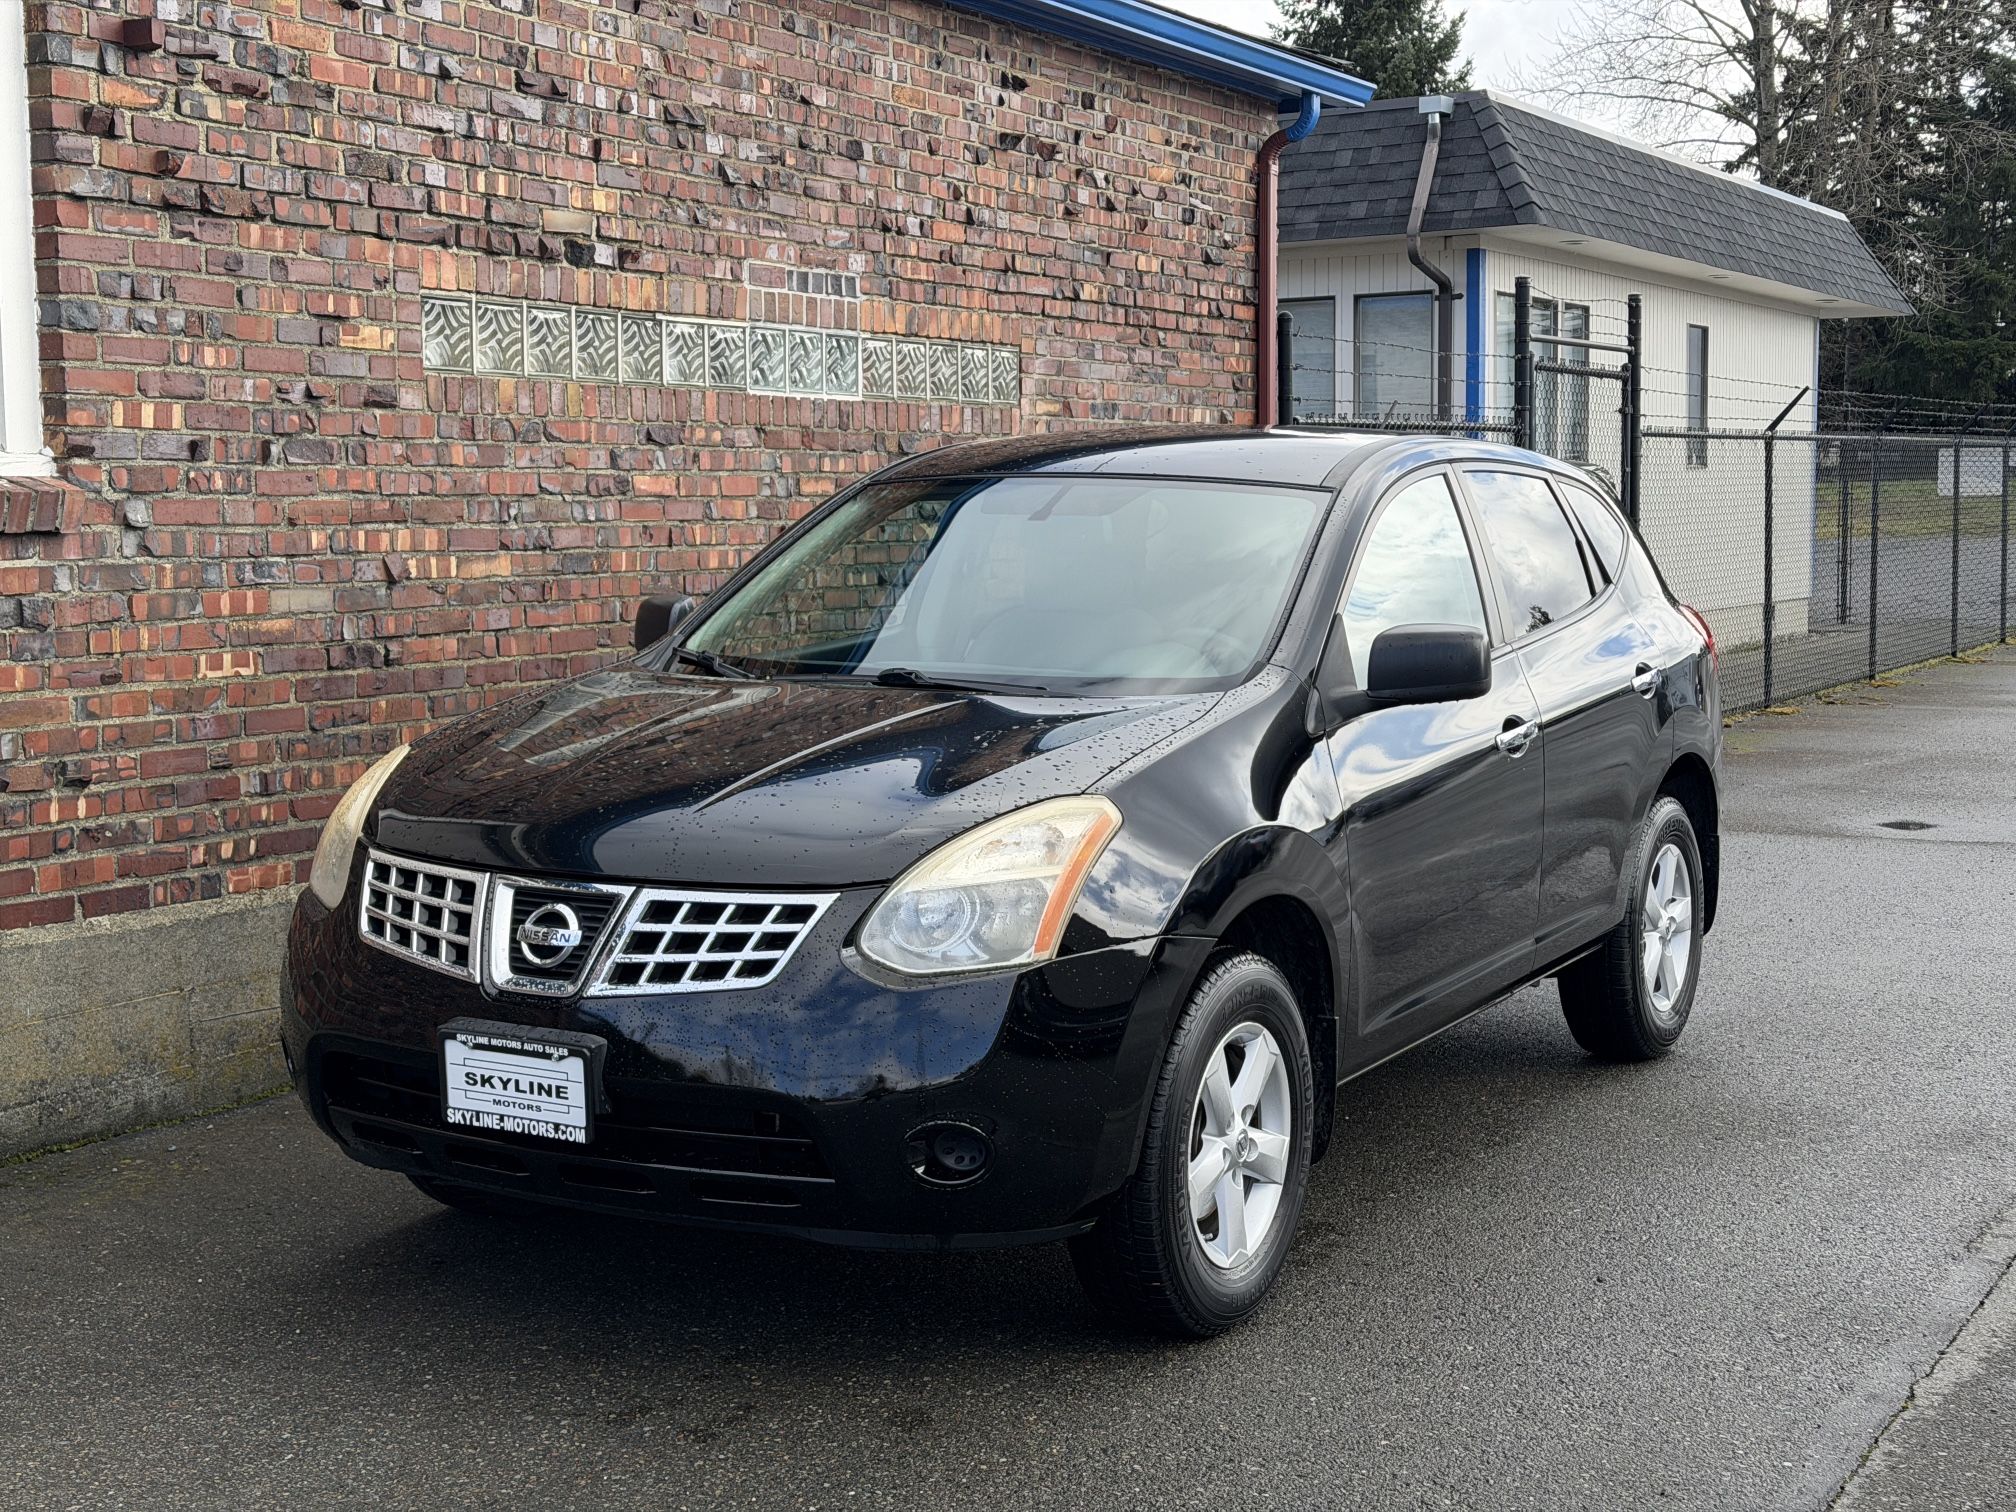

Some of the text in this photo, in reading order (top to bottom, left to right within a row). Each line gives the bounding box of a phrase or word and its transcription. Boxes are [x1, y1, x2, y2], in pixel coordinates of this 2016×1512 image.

[520, 925, 571, 943] NISSAN
[456, 1033, 568, 1056] SKYLINE MOTORS AUTO SALES
[464, 1071, 569, 1101] SKYLINE
[492, 1098, 542, 1113] MOTORS
[1298, 1041, 1313, 1188] VREDESTEIN
[446, 1108, 586, 1144] SKYLINE-MOTORS.COM
[1174, 1097, 1191, 1265] VREDESTEIN
